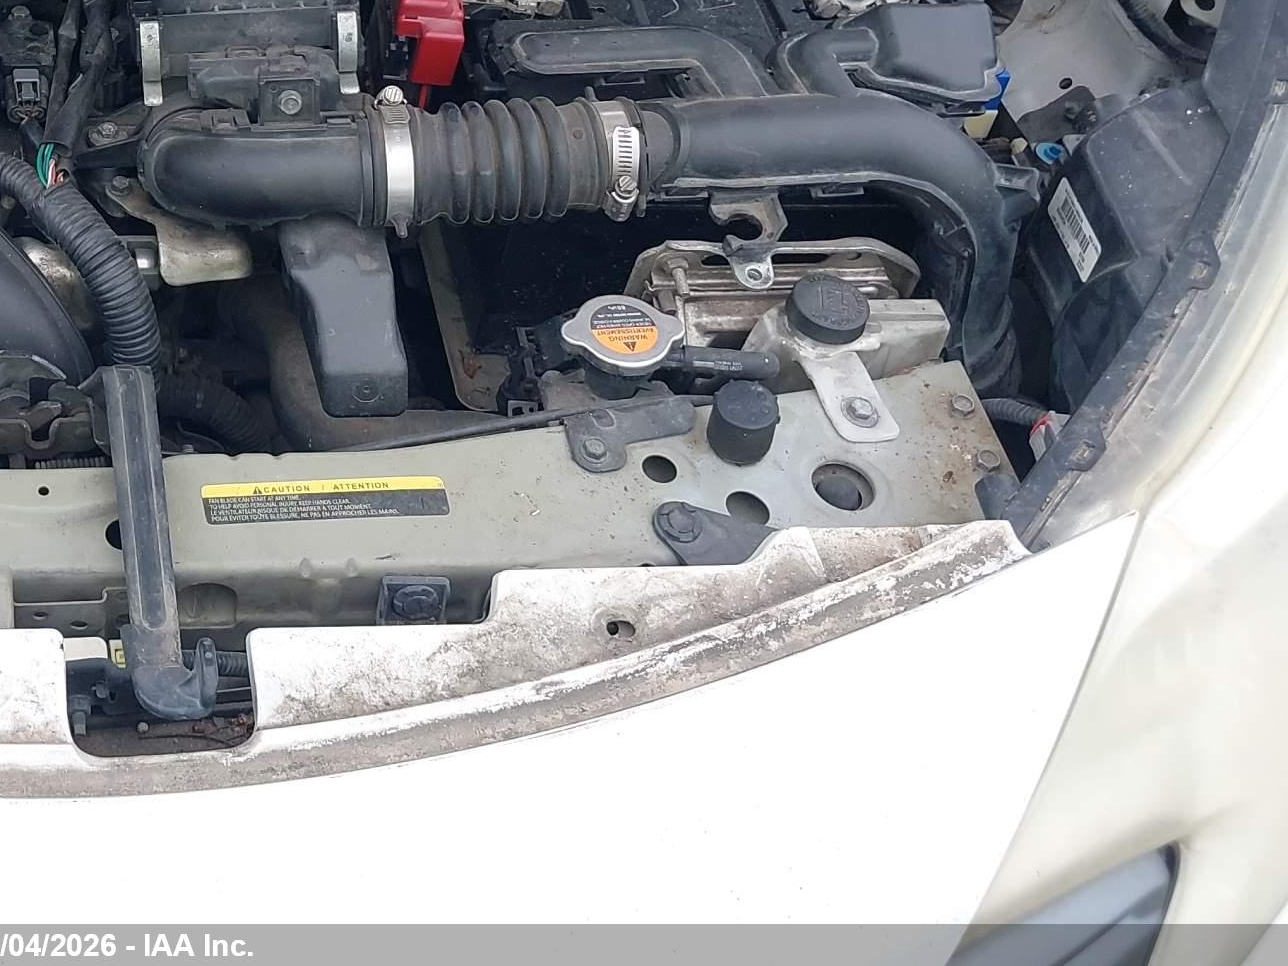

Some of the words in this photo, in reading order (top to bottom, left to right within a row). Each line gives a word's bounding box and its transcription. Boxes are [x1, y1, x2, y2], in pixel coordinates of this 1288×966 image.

[608, 334, 648, 342] WARNING
[263, 485, 310, 493] CAUTION
[333, 481, 389, 490] ATTENTION
[217, 508, 256, 516] VENTILATEUR
